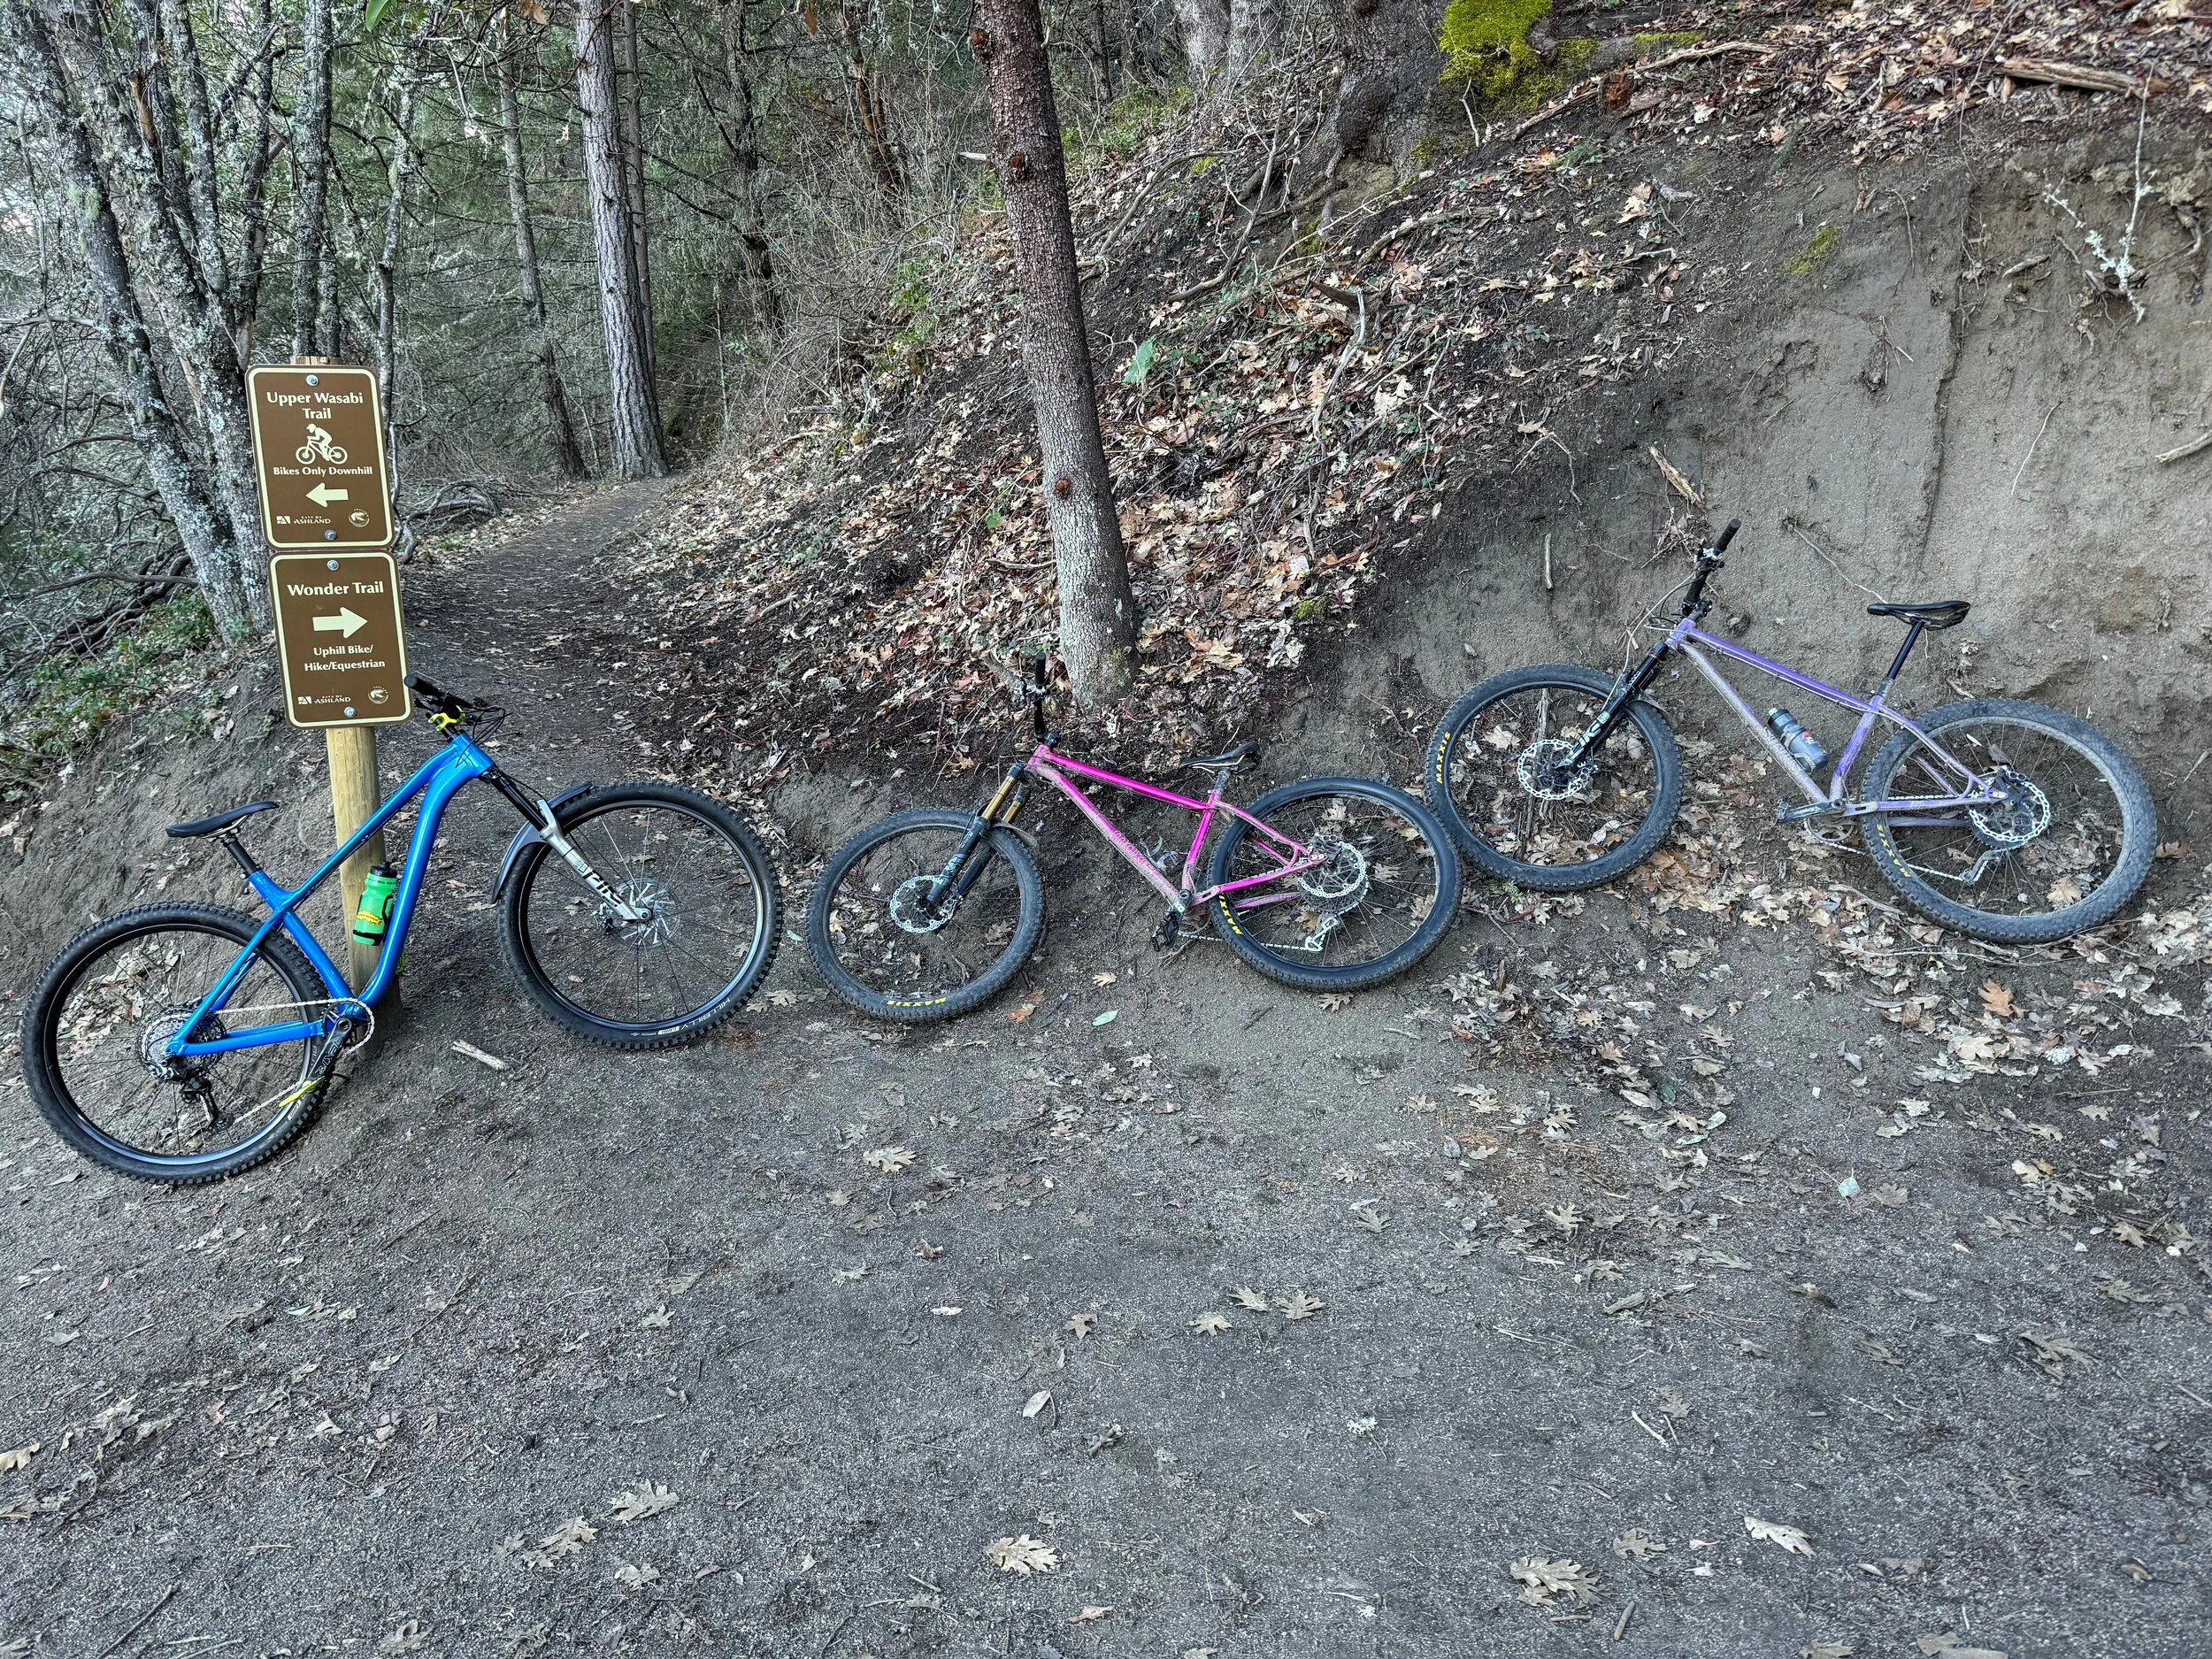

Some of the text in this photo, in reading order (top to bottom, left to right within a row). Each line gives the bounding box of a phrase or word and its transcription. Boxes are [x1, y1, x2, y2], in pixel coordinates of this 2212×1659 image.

[266, 391, 364, 406] Upper Wasabi
[302, 408, 332, 419] Trail
[302, 467, 326, 478] Only
[328, 466, 373, 475] Downhill
[287, 580, 384, 596] Wonder Trail
[313, 644, 373, 657] Uphill Bike/
[303, 660, 386, 672] Hike/Equestrian
[1436, 731, 1451, 784] MAXXIS
[1877, 824, 1911, 878] MAXXIS
[1218, 893, 1243, 934] MAXXI
[887, 997, 947, 1007] MAXXIS
[680, 997, 731, 1030] HILLBILLY
